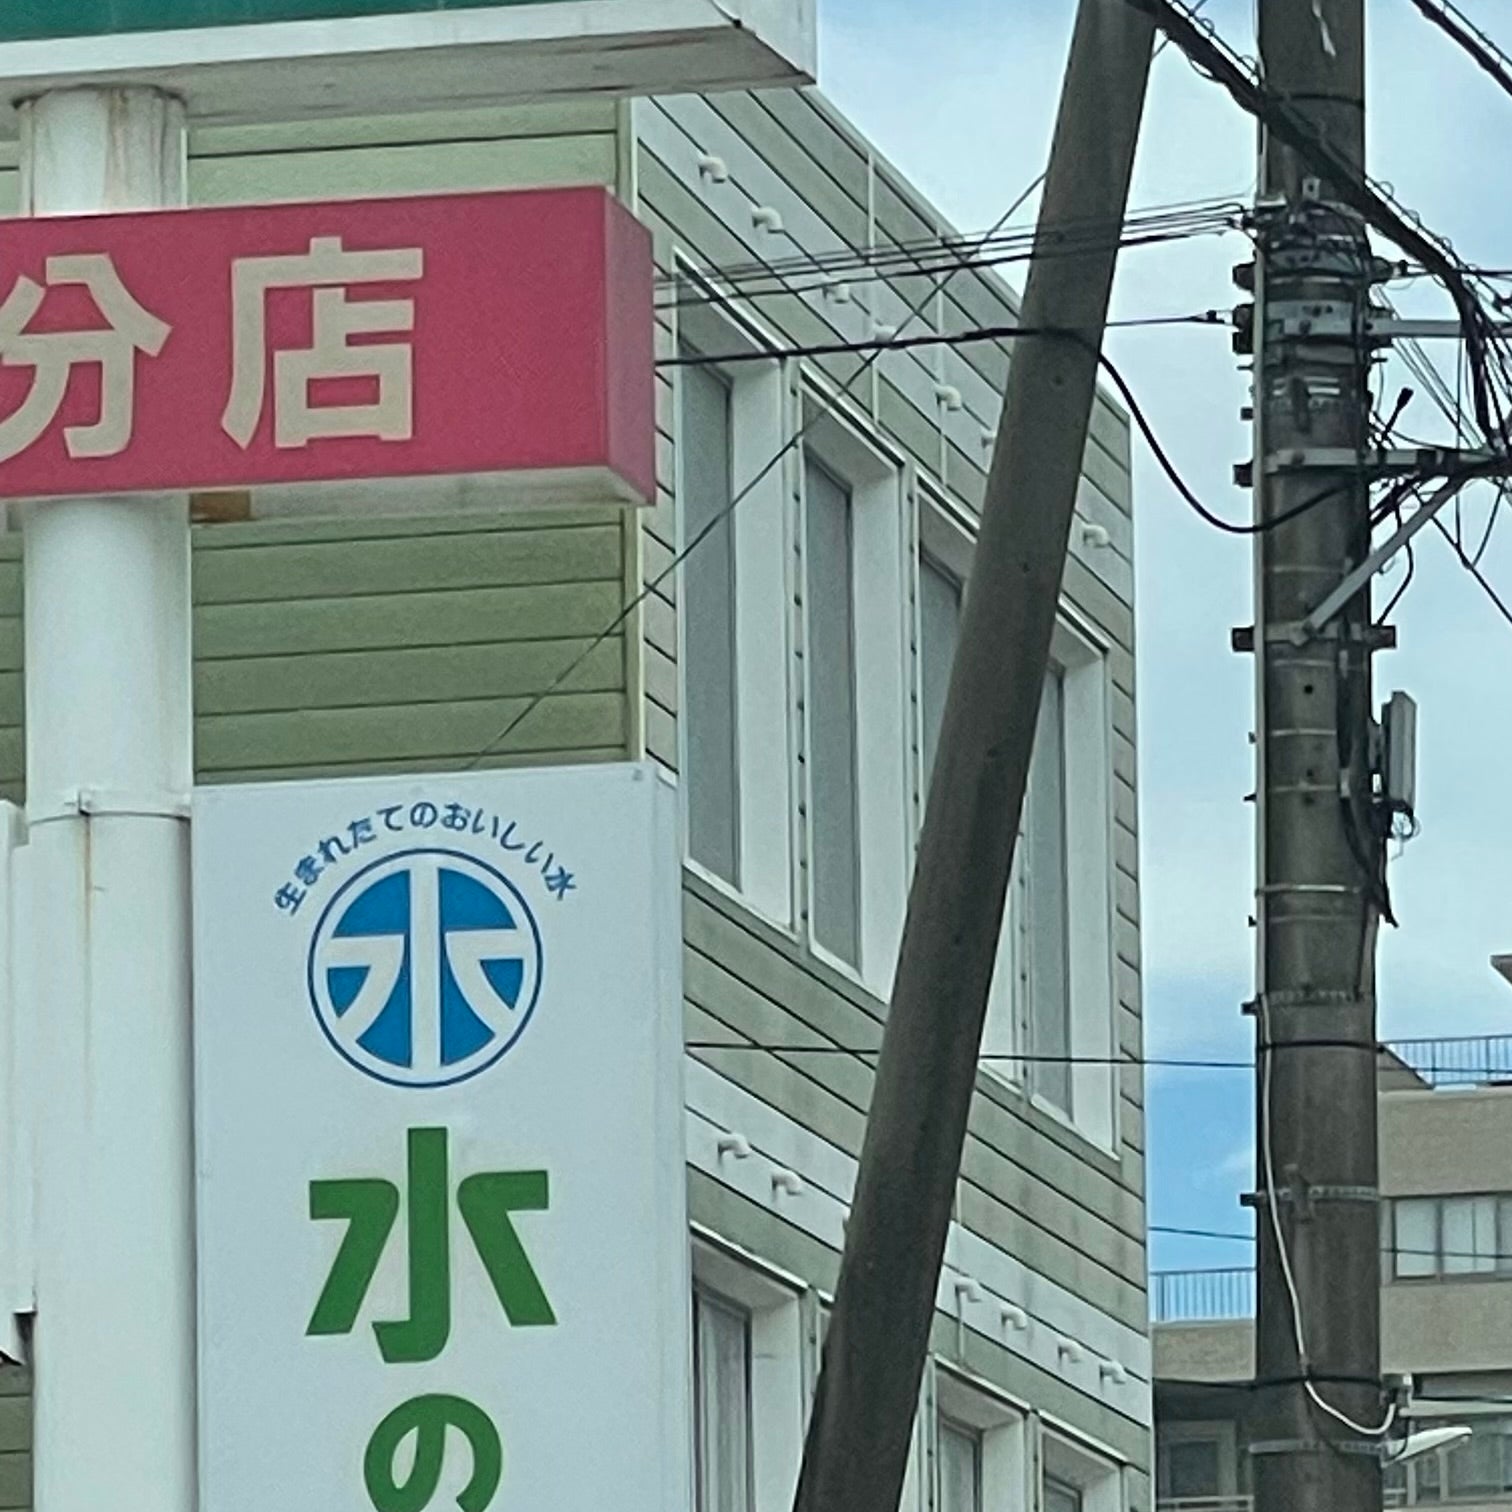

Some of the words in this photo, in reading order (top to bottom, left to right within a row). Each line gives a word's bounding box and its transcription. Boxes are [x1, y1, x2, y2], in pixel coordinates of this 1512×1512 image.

[0, 237, 424, 468] 分店
[274, 801, 576, 916] 生まれたてのおいしい水
